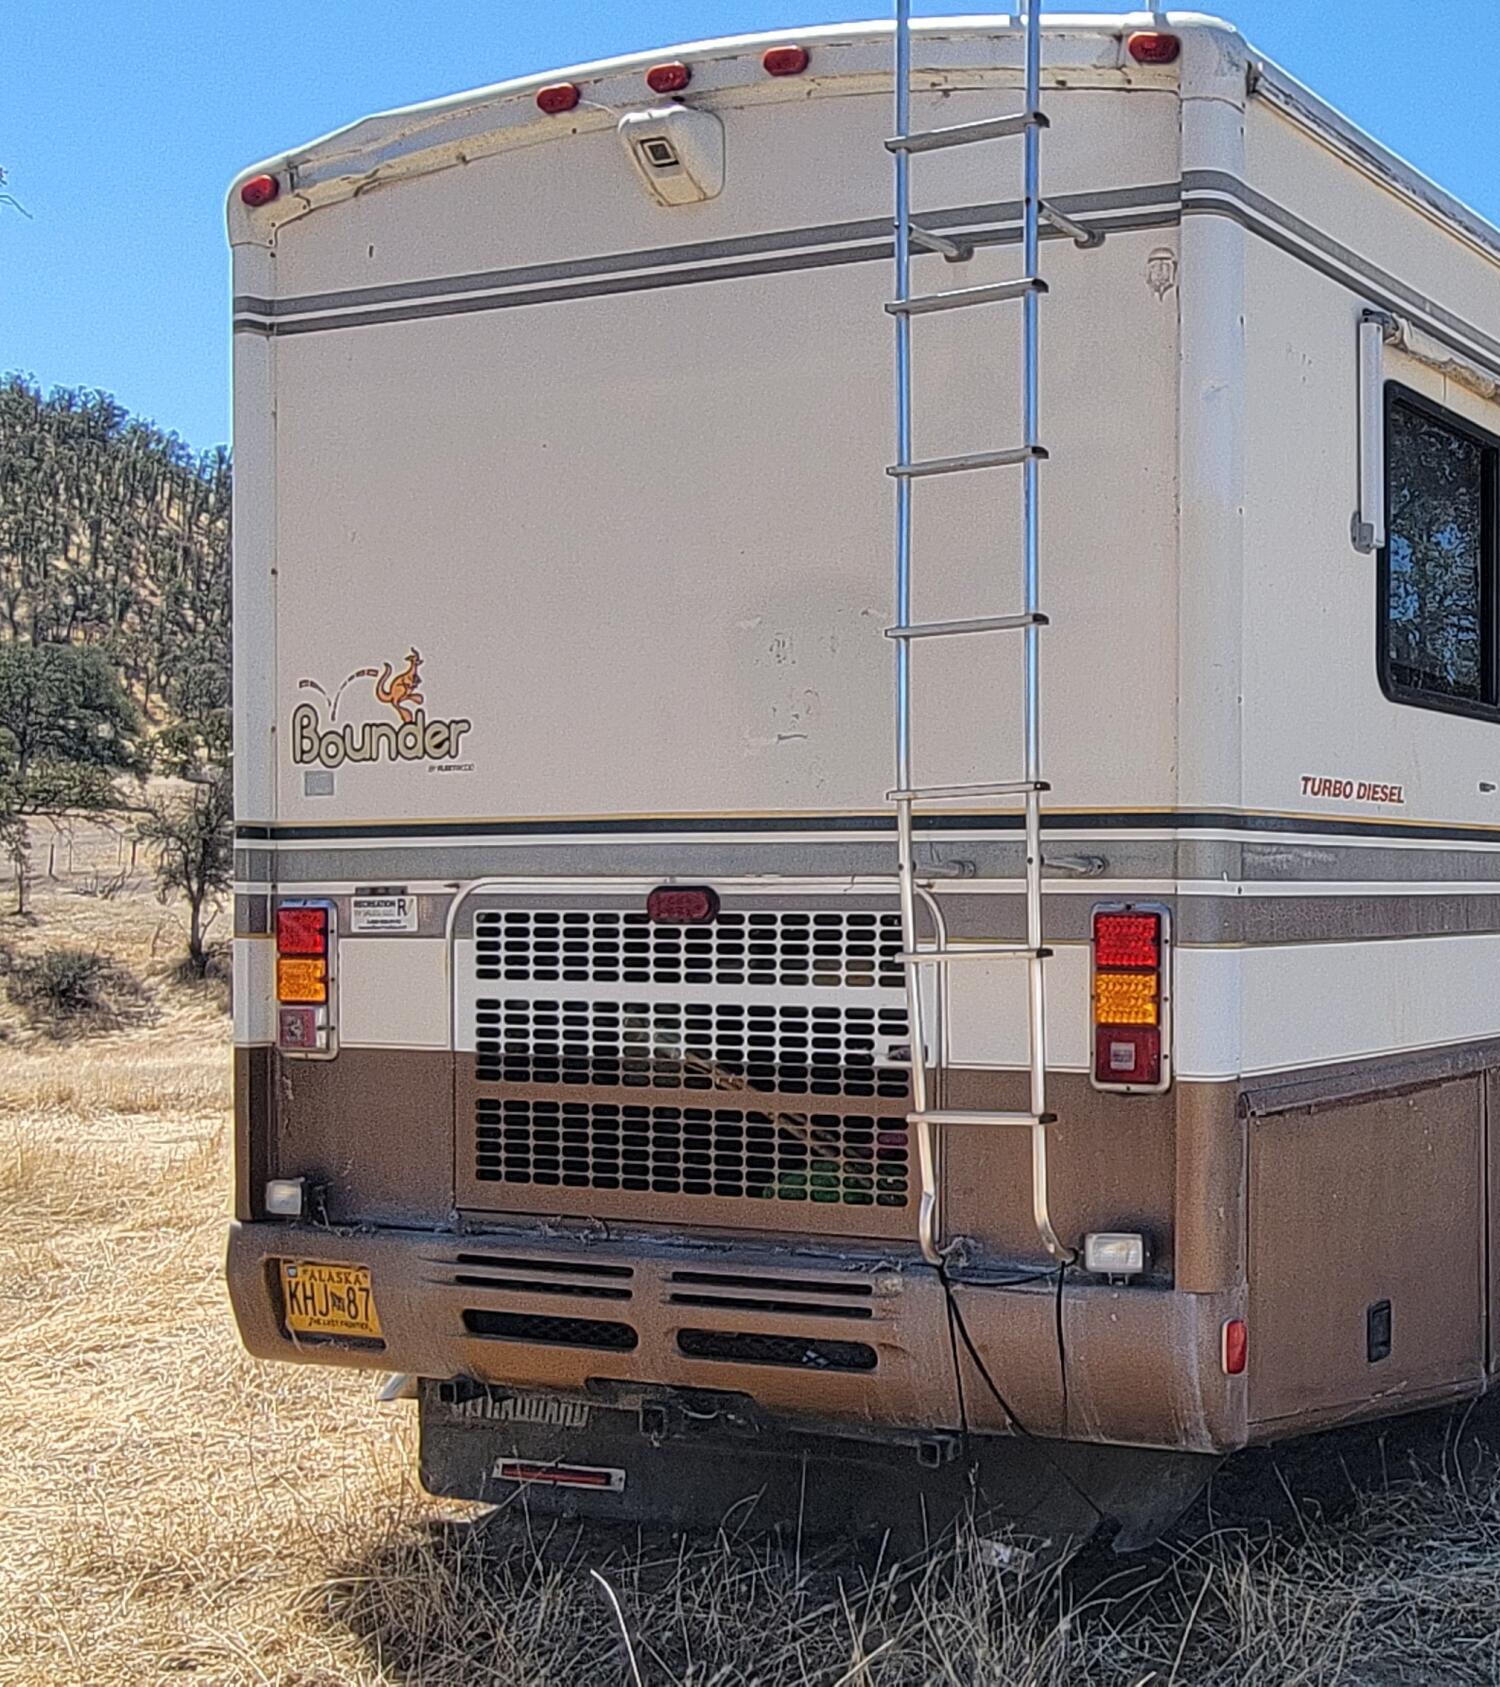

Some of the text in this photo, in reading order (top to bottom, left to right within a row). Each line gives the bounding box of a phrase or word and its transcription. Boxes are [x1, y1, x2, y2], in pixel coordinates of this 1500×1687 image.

[292, 703, 471, 768] Bounder
[1301, 776, 1404, 803] TURBO DIESEL
[308, 1269, 362, 1286] ALASKA
[288, 1280, 370, 1321] KHJ 87
